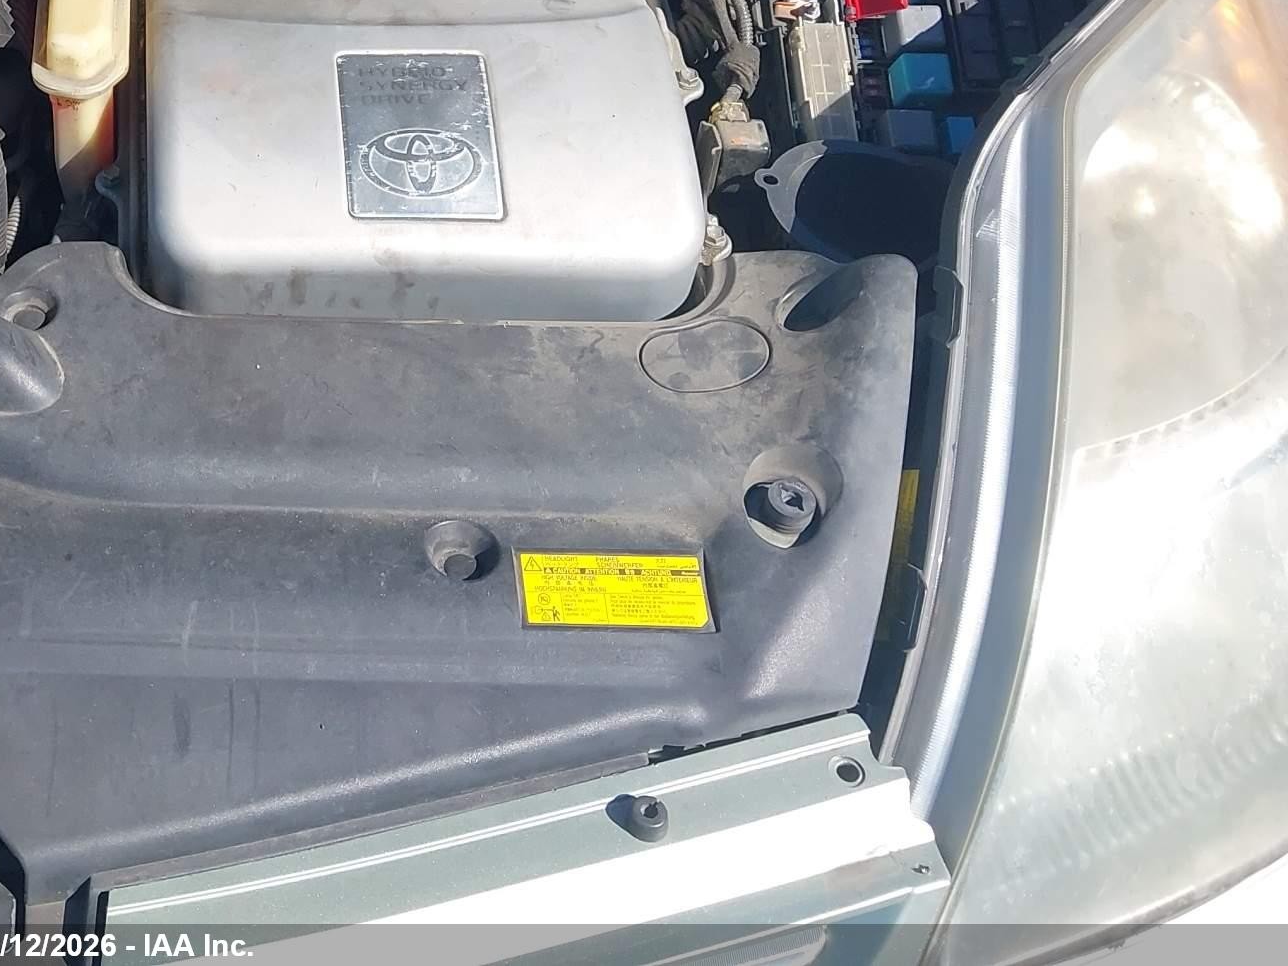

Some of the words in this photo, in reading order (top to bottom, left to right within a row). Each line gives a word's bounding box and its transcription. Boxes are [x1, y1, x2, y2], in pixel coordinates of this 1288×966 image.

[358, 66, 447, 78] HYBRID
[359, 79, 468, 91] SYNERGY
[360, 93, 431, 105] DRIVE
[552, 567, 581, 575] CAUTION
[584, 568, 620, 576] ATTENTION
